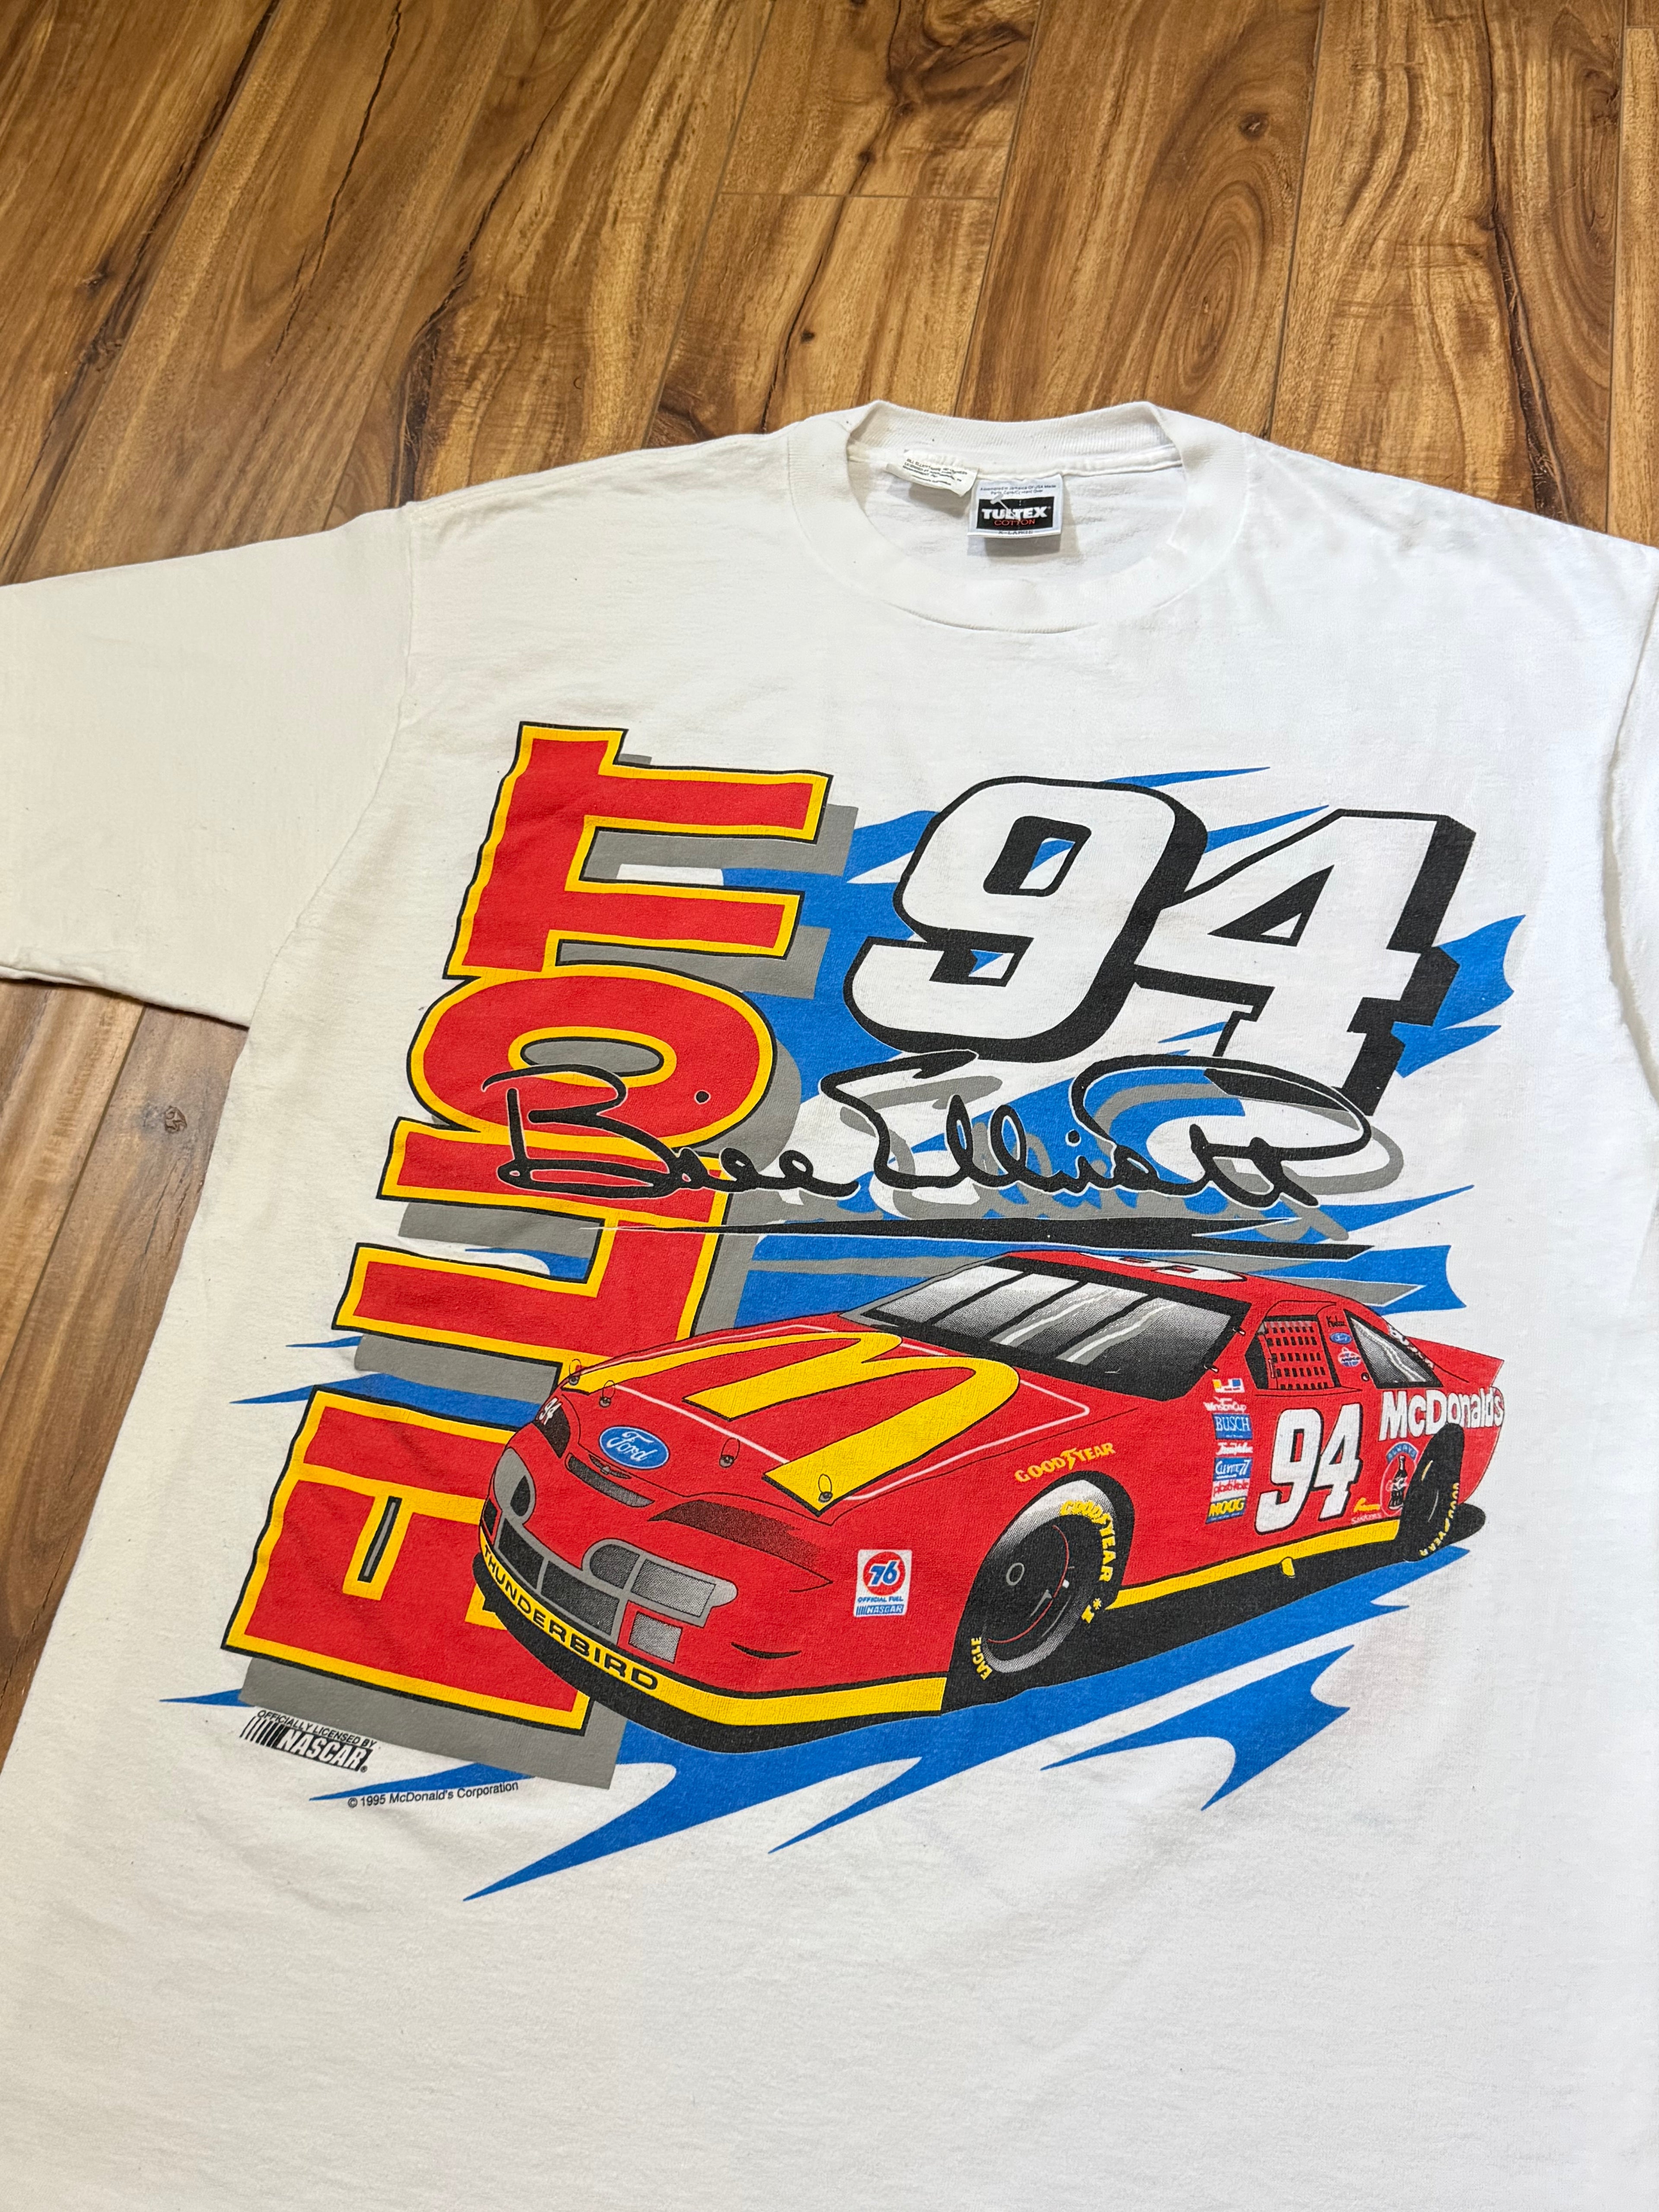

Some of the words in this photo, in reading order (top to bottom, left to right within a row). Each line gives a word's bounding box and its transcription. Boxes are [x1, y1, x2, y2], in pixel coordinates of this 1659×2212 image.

[981, 506, 1048, 520] TULTEX
[844, 776, 1475, 1116] 94
[539, 1397, 562, 1426] 94
[1214, 1416, 1251, 1432] BUSCH
[606, 1430, 658, 1462] Ford
[1387, 1444, 1417, 1460] ALWAYS
[1255, 1402, 1363, 1535] 94
[1208, 1497, 1246, 1517] MOOG
[869, 1560, 899, 1586] 76
[483, 1544, 659, 1692] THUNDERBIRD
[866, 1605, 903, 1614] NASCAR
[971, 1637, 993, 1680] EAGLE
[257, 1710, 313, 1734] OFFICIALLY
[312, 1725, 361, 1745] LICENSED
[361, 1738, 378, 1748] BY
[360, 1794, 386, 1807] 1995
[389, 1789, 454, 1804] McDonald's
[457, 1781, 519, 1799] Corporation
